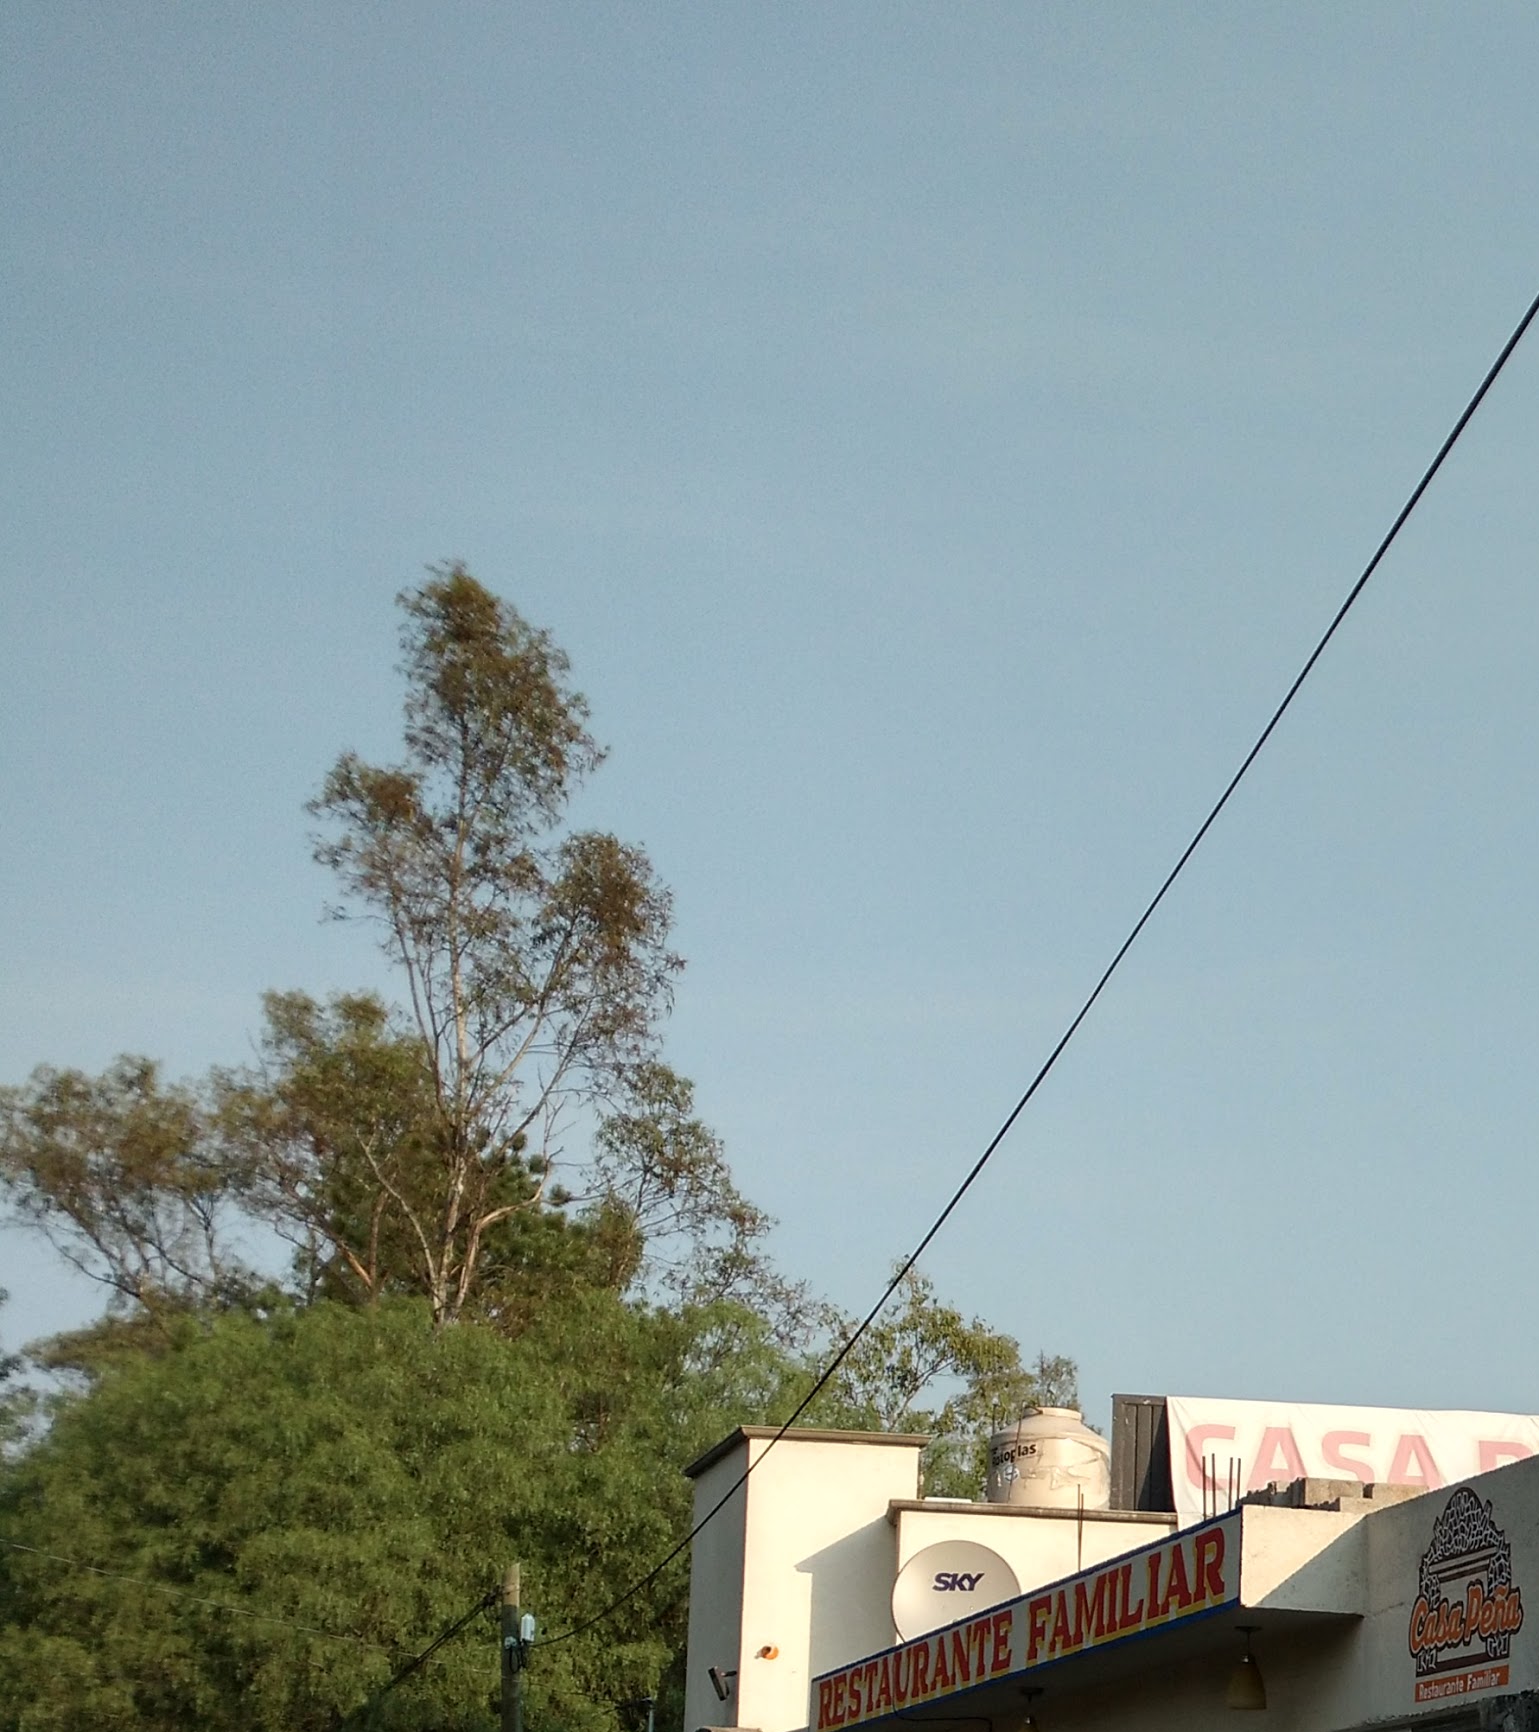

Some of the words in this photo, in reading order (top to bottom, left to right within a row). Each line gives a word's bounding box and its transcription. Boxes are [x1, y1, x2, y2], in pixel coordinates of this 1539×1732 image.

[1186, 1424, 1444, 1493] CASA
[933, 1572, 985, 1592] SKY
[1026, 1526, 1225, 1668] FAMILIAR
[1410, 1596, 1465, 1654] Casa
[1464, 1584, 1521, 1642] Peña
[1419, 1680, 1464, 1700] Restaurante
[1467, 1669, 1500, 1692] Familiar
